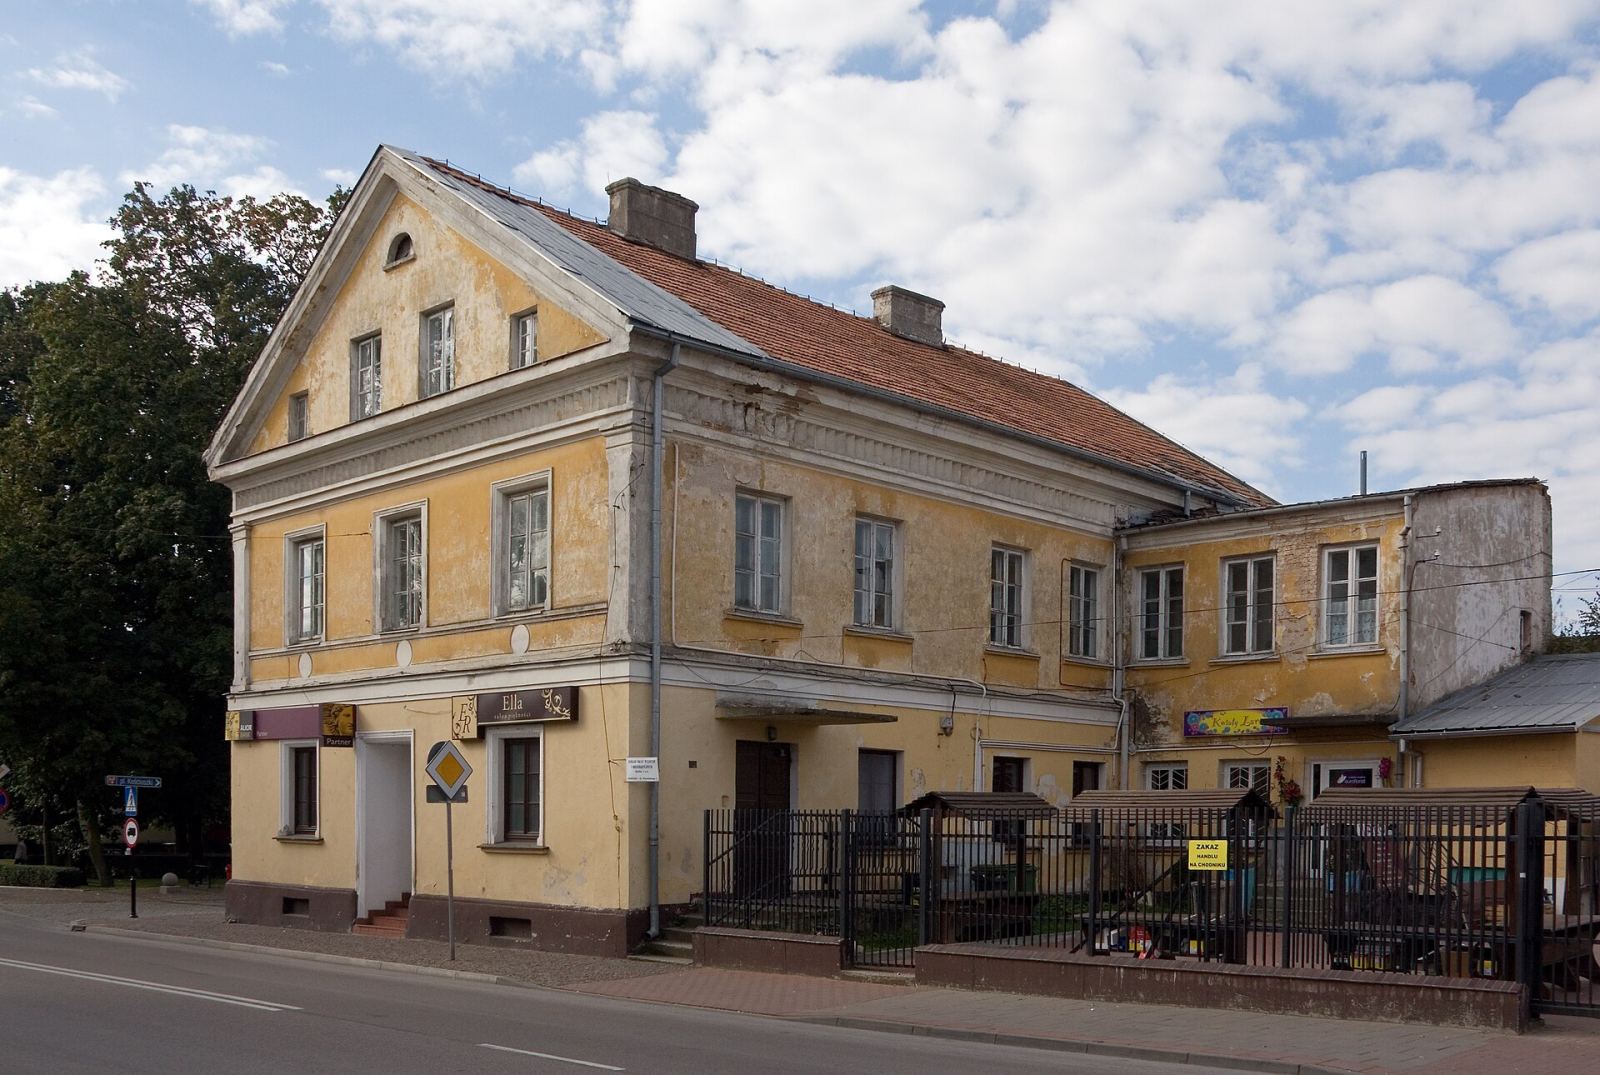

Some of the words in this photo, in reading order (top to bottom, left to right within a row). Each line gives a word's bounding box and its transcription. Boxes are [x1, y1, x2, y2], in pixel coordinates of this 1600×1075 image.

[502, 695, 523, 710] Ella
[1240, 715, 1260, 726] Lar
[326, 738, 352, 746] Partner
